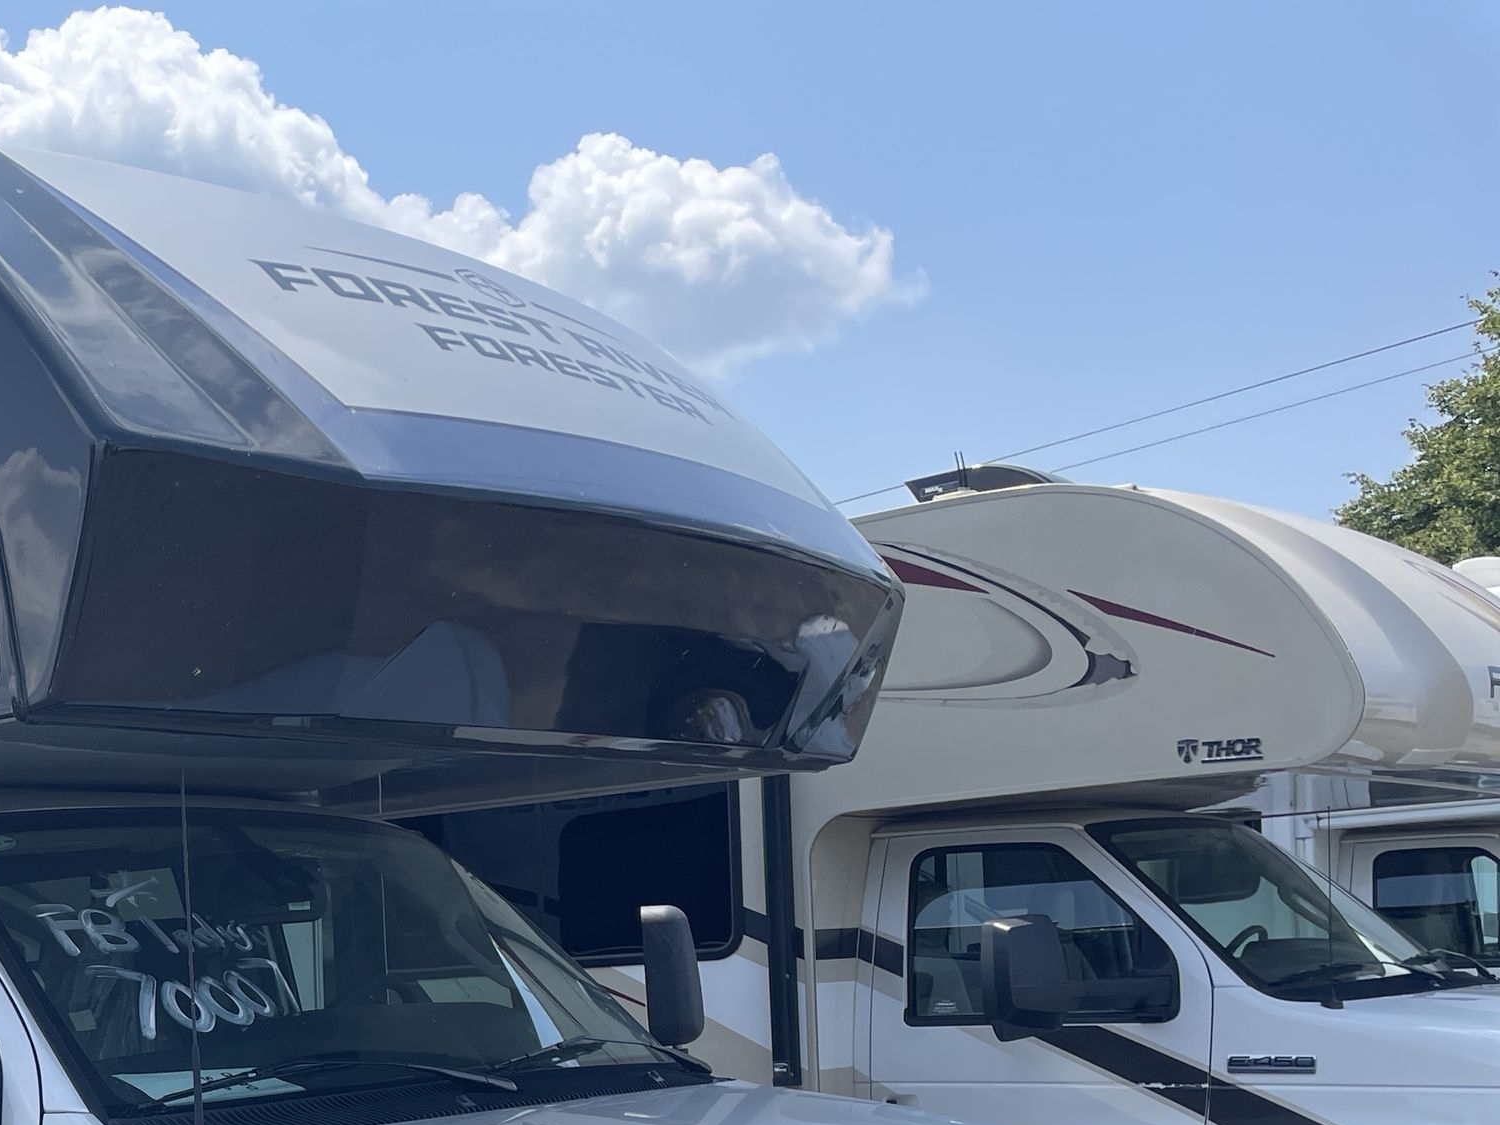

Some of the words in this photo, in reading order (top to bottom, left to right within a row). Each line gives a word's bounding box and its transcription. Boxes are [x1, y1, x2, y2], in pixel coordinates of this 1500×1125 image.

[247, 258, 561, 344] FOREST
[561, 327, 739, 421] RIVER
[414, 322, 714, 426] FORESTER
[1201, 737, 1263, 759] THOR
